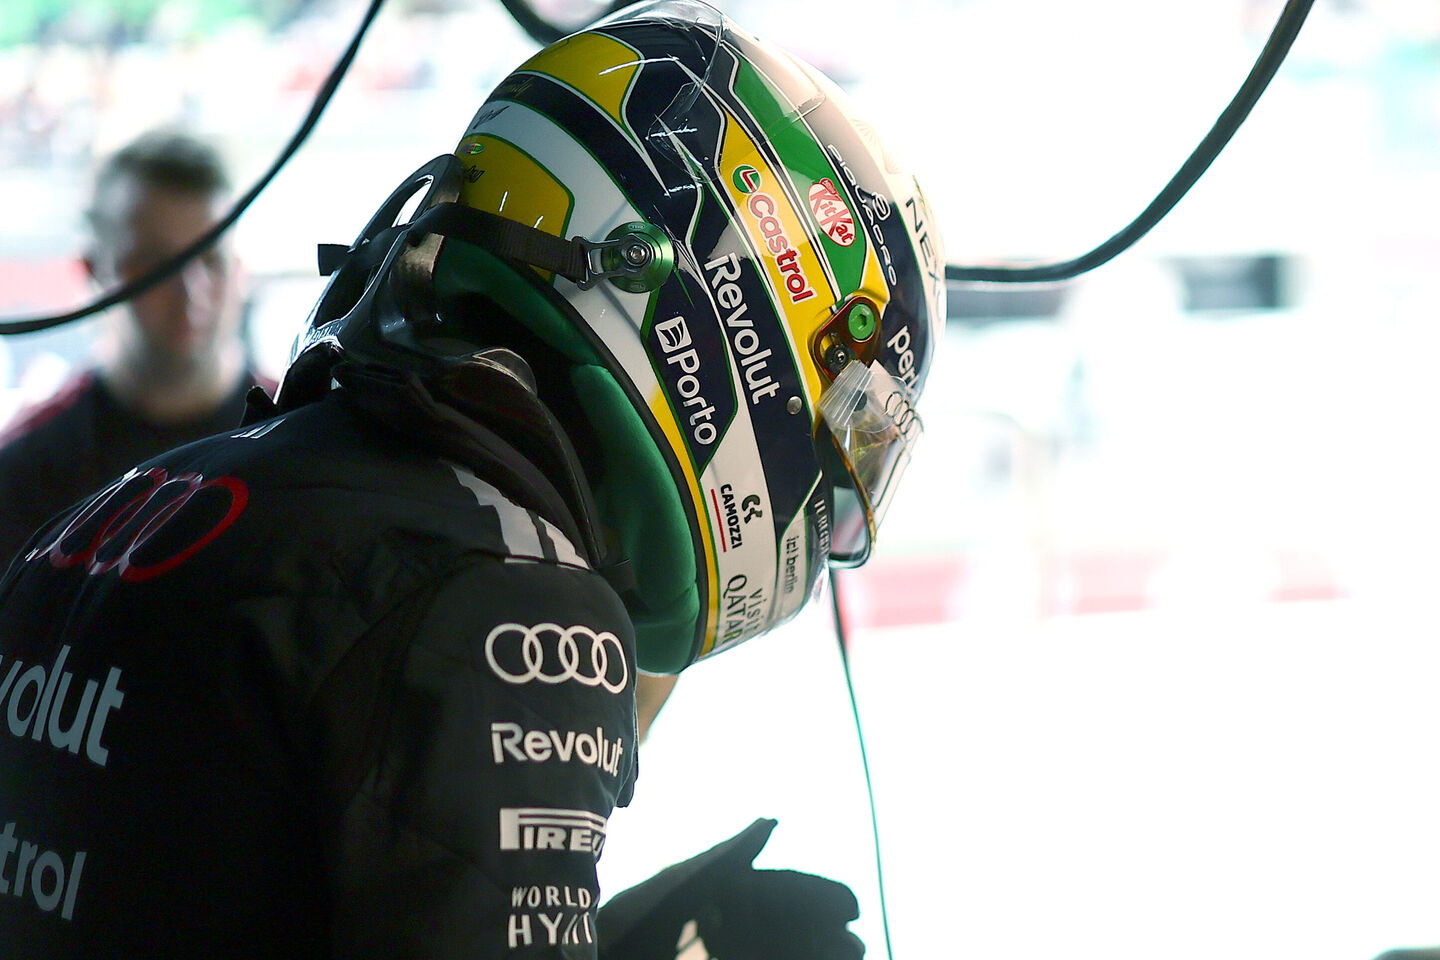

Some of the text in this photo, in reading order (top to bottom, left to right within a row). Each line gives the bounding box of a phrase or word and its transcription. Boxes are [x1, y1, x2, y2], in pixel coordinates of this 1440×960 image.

[749, 194, 816, 304] Castrol
[809, 188, 853, 244] KitKat
[828, 144, 897, 286] PIQUADRO
[703, 252, 781, 405] Revolut
[666, 348, 717, 445] Porto
[720, 483, 743, 549] CAMOZZI
[722, 574, 748, 645] QATAR
[490, 721, 624, 777] Revolut
[511, 885, 592, 909] WORLD
